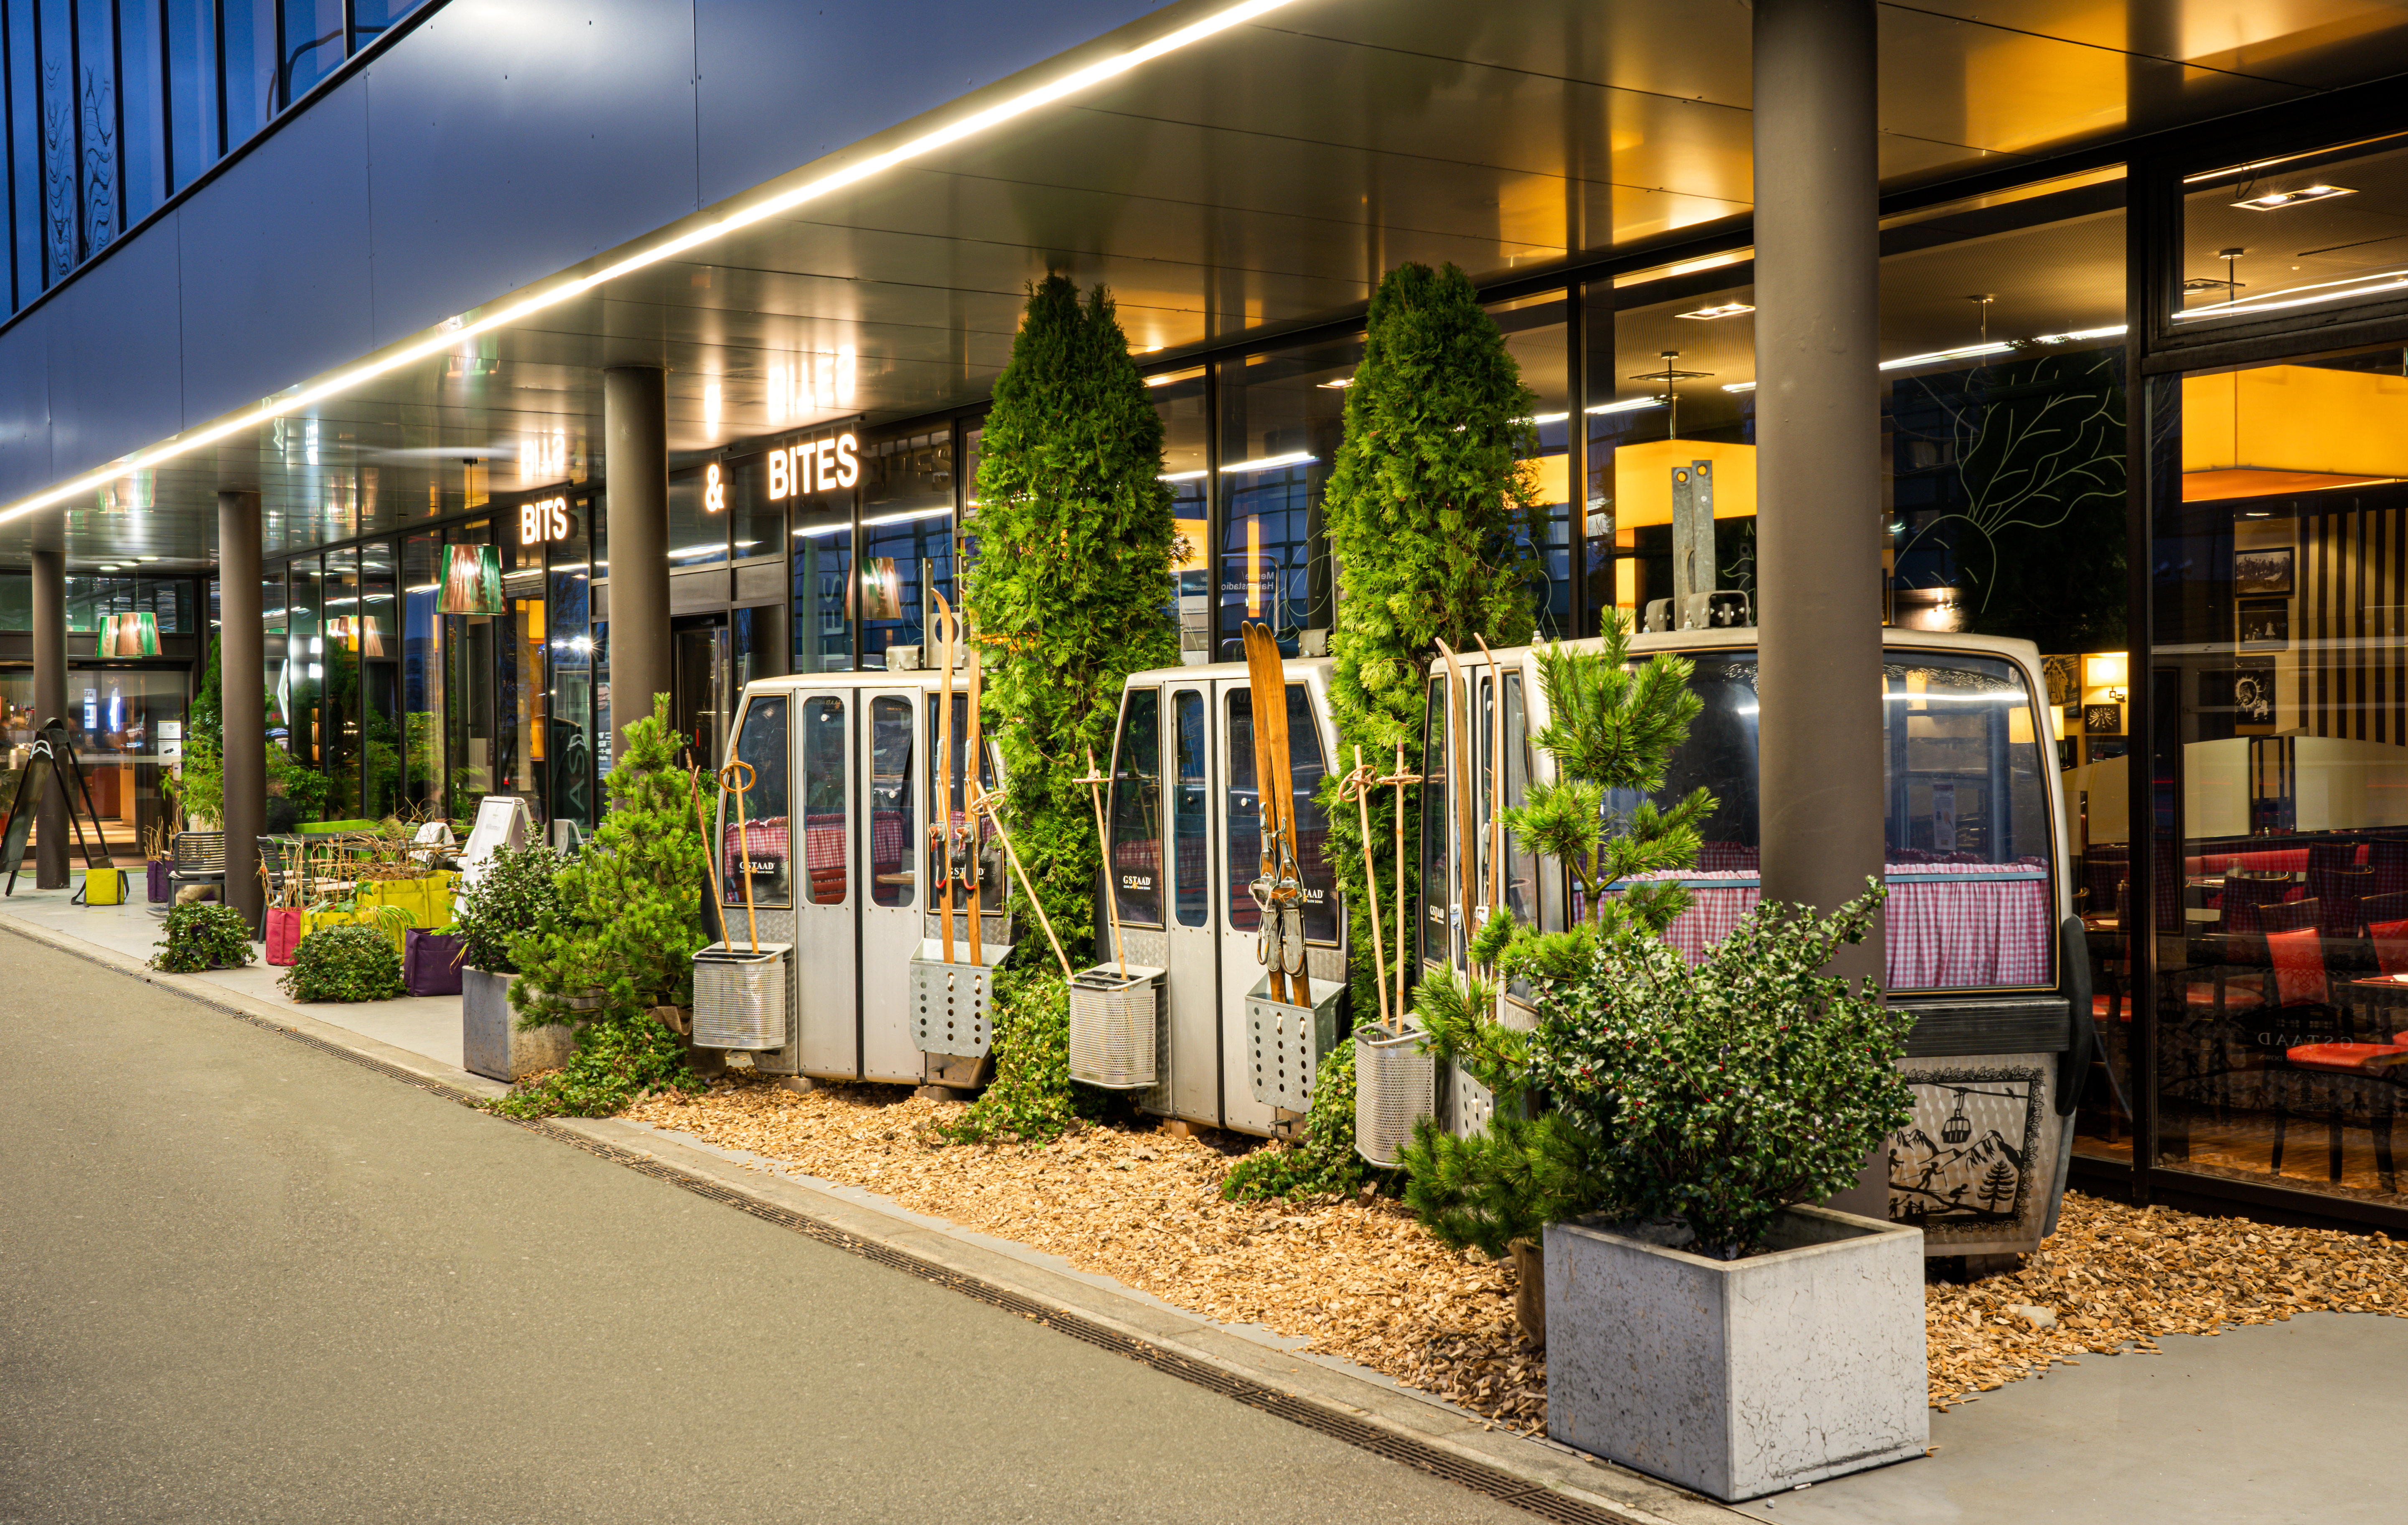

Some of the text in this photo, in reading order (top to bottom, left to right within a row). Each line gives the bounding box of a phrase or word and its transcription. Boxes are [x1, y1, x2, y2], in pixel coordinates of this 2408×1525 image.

[521, 497, 567, 544] BITS
[706, 464, 724, 512] &
[769, 434, 858, 500] BITES
[1123, 876, 1150, 885] GSTAAD
[1303, 889, 1323, 898] TAAD
[1430, 905, 1444, 918] GSTAAD
